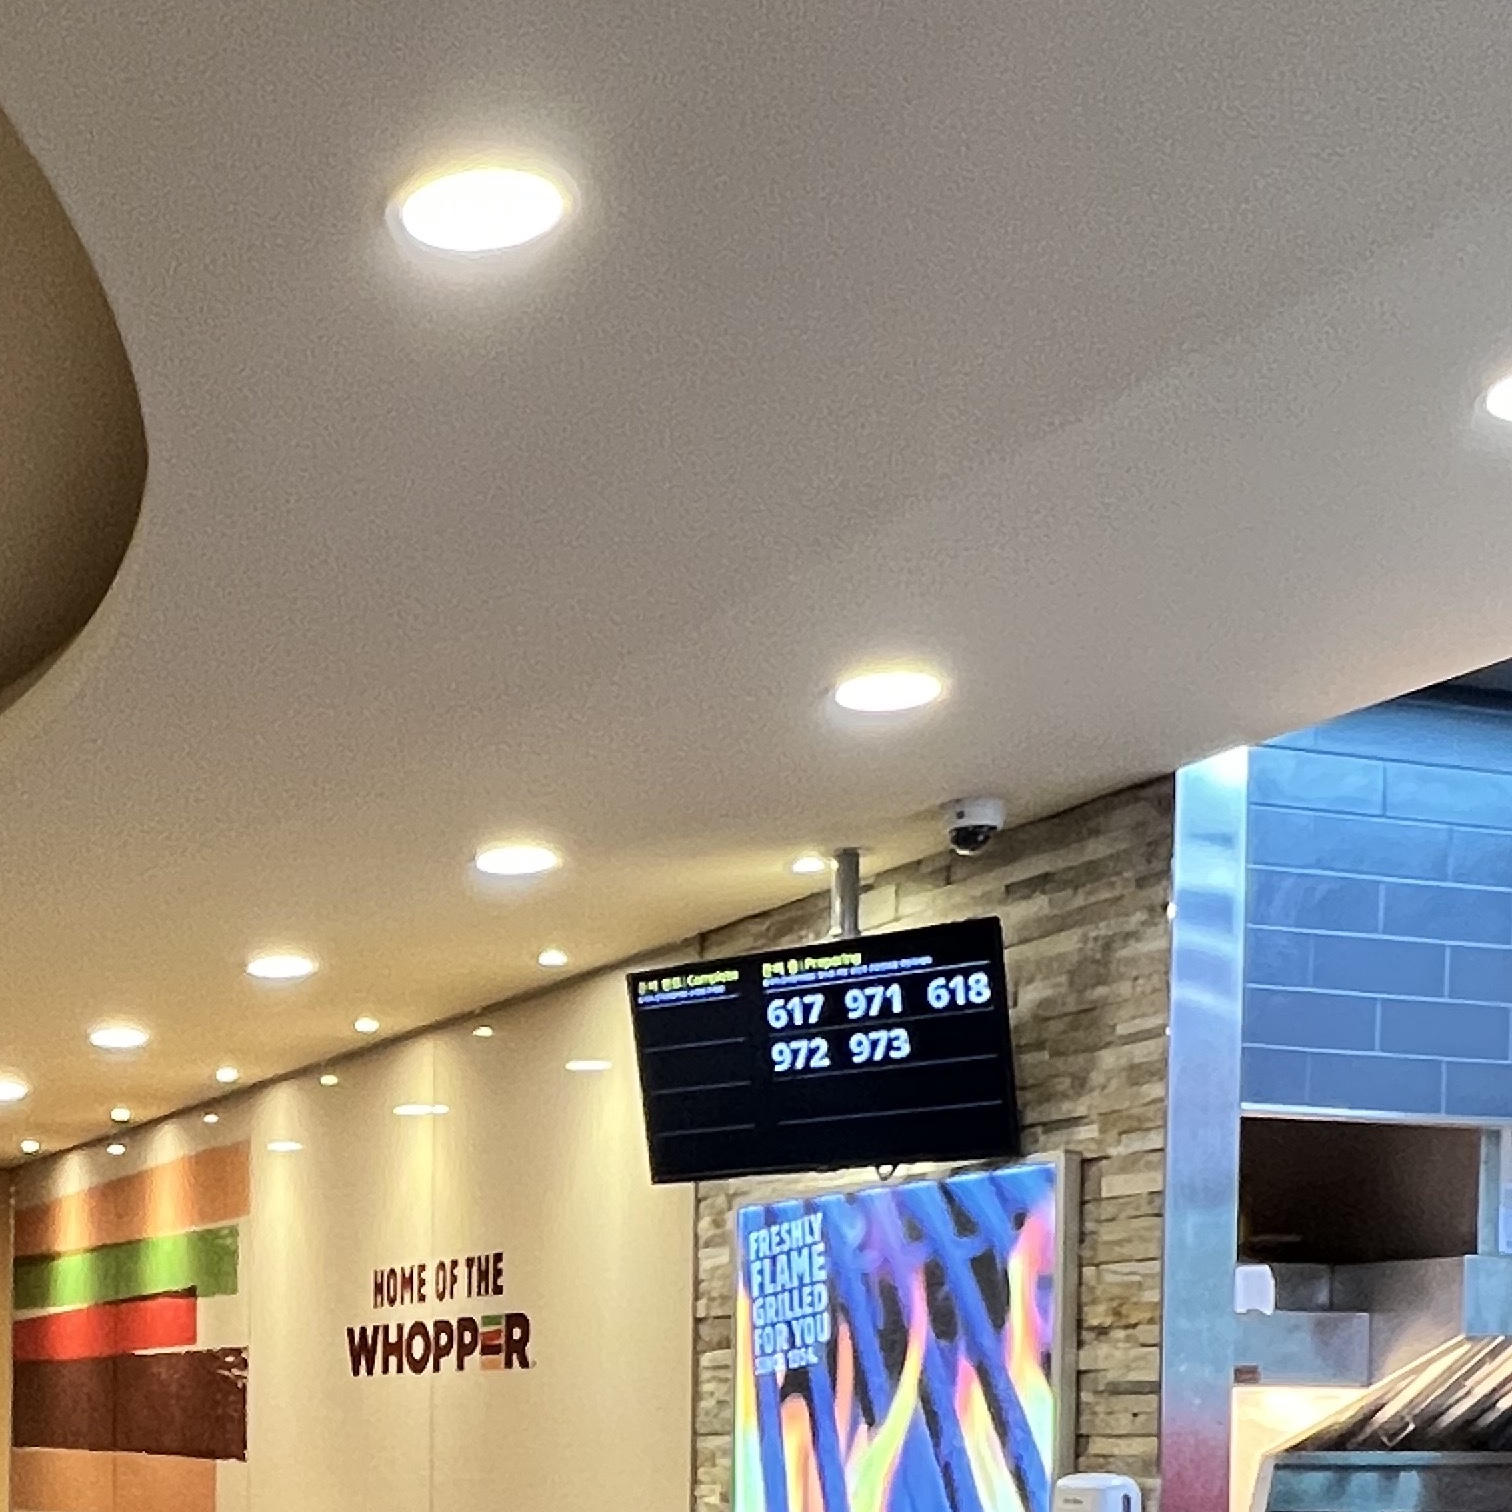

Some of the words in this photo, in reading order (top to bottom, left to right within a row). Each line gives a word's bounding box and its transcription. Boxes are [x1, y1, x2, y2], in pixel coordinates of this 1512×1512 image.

[767, 994, 824, 1028] 617
[845, 984, 903, 1019] 971
[927, 972, 991, 1009] 618
[771, 1037, 830, 1072] 972
[849, 1028, 911, 1064] 973
[749, 1213, 823, 1260] FRESHLY
[372, 1264, 426, 1309] HOME
[435, 1259, 458, 1301] OF
[465, 1252, 503, 1297] THE
[751, 1243, 827, 1298] FLAME
[753, 1284, 828, 1326] GRILLED
[346, 1312, 530, 1377] WHOPPER
[754, 1323, 788, 1356] FOR
[791, 1312, 831, 1348] YOU
